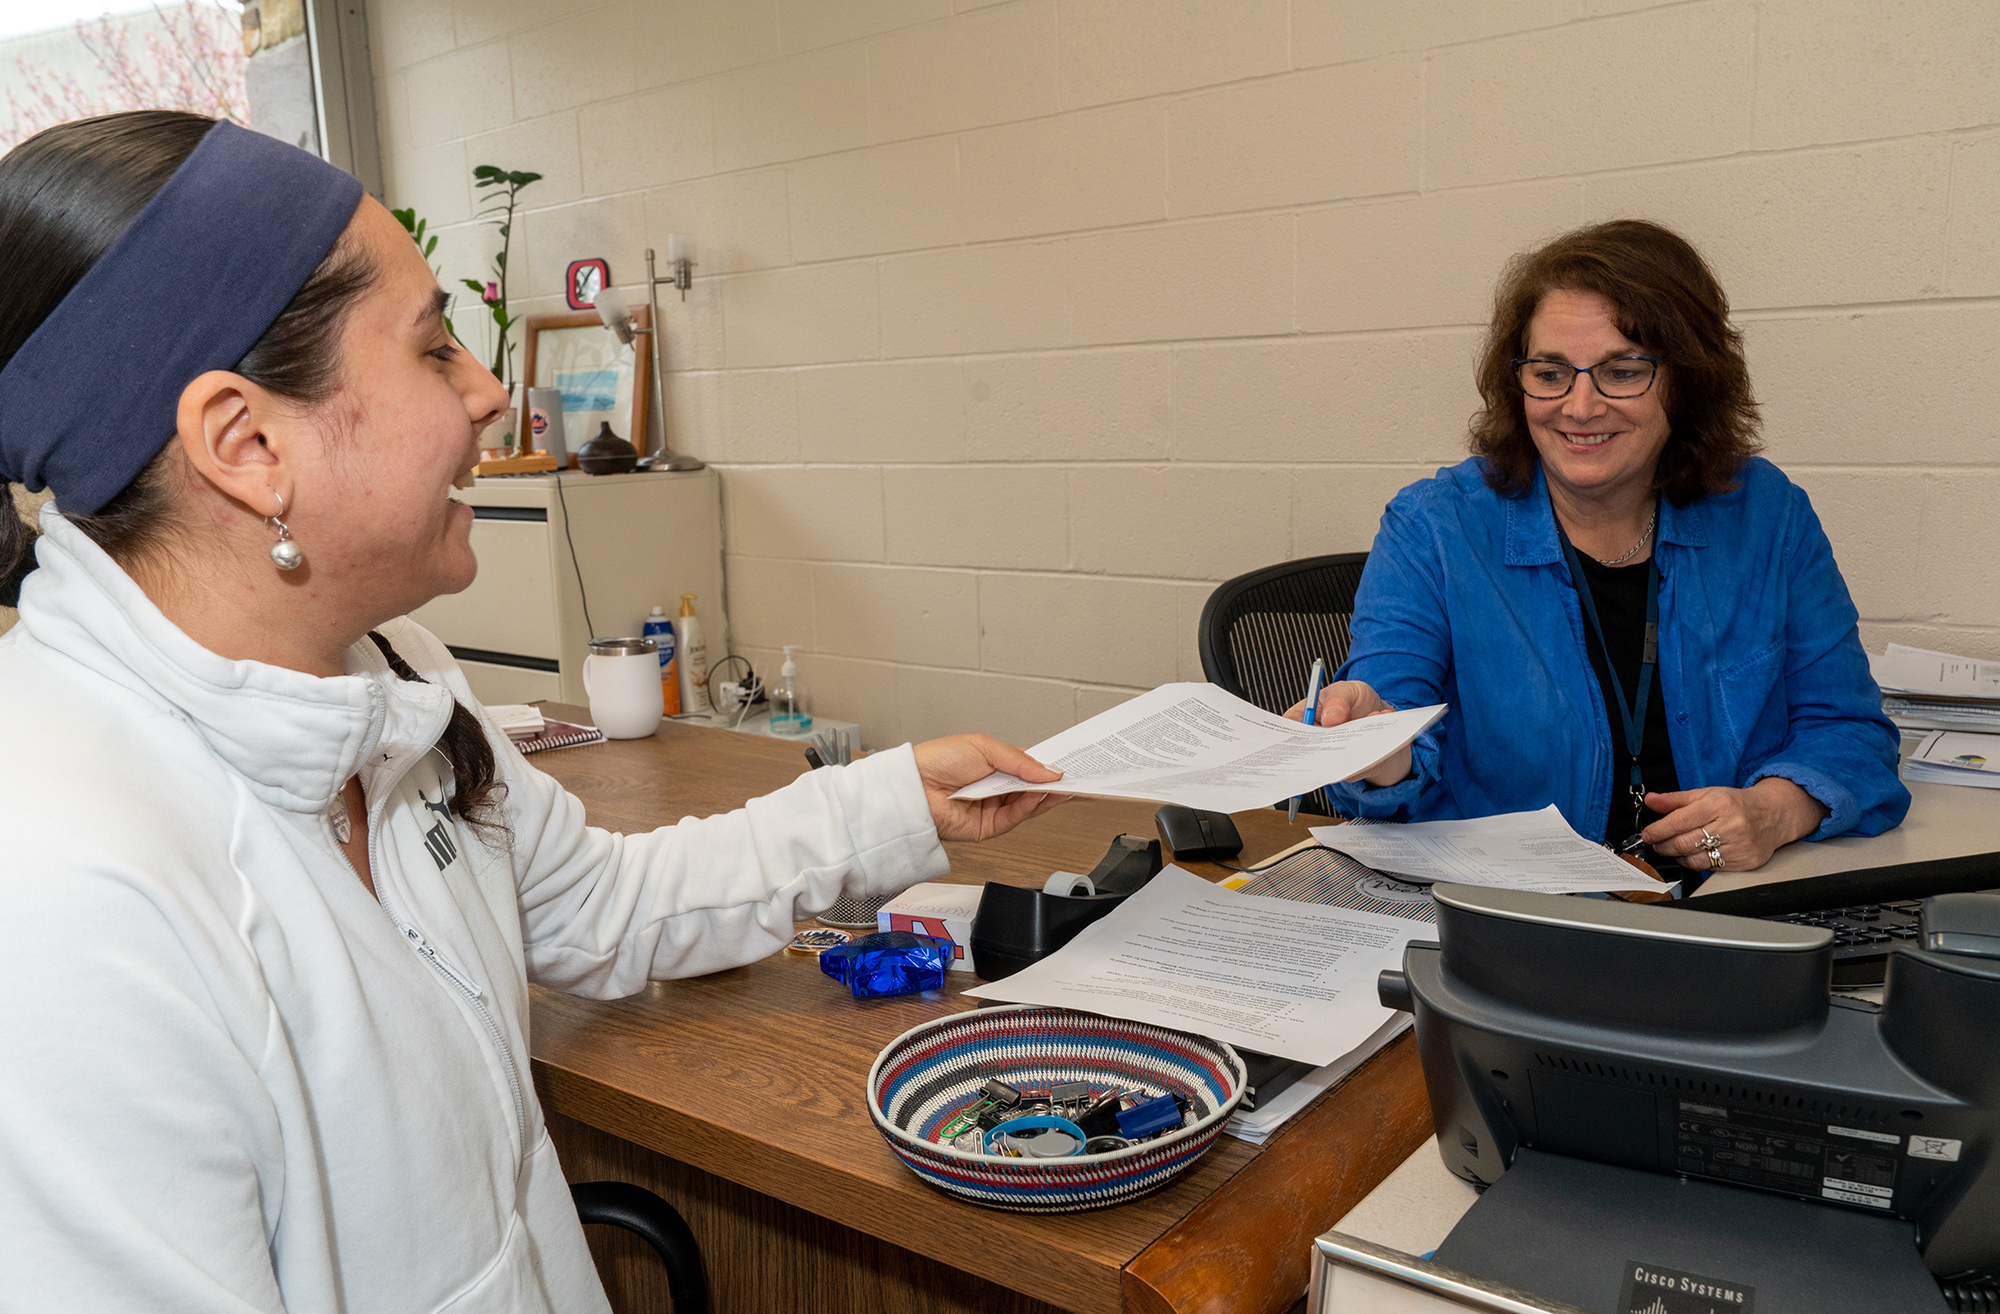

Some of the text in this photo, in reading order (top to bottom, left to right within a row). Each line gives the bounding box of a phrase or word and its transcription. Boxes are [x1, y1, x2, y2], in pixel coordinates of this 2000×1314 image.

[892, 902, 971, 917] RUTGERS
[1634, 1267, 1744, 1303] CISCO SYSTEMS
